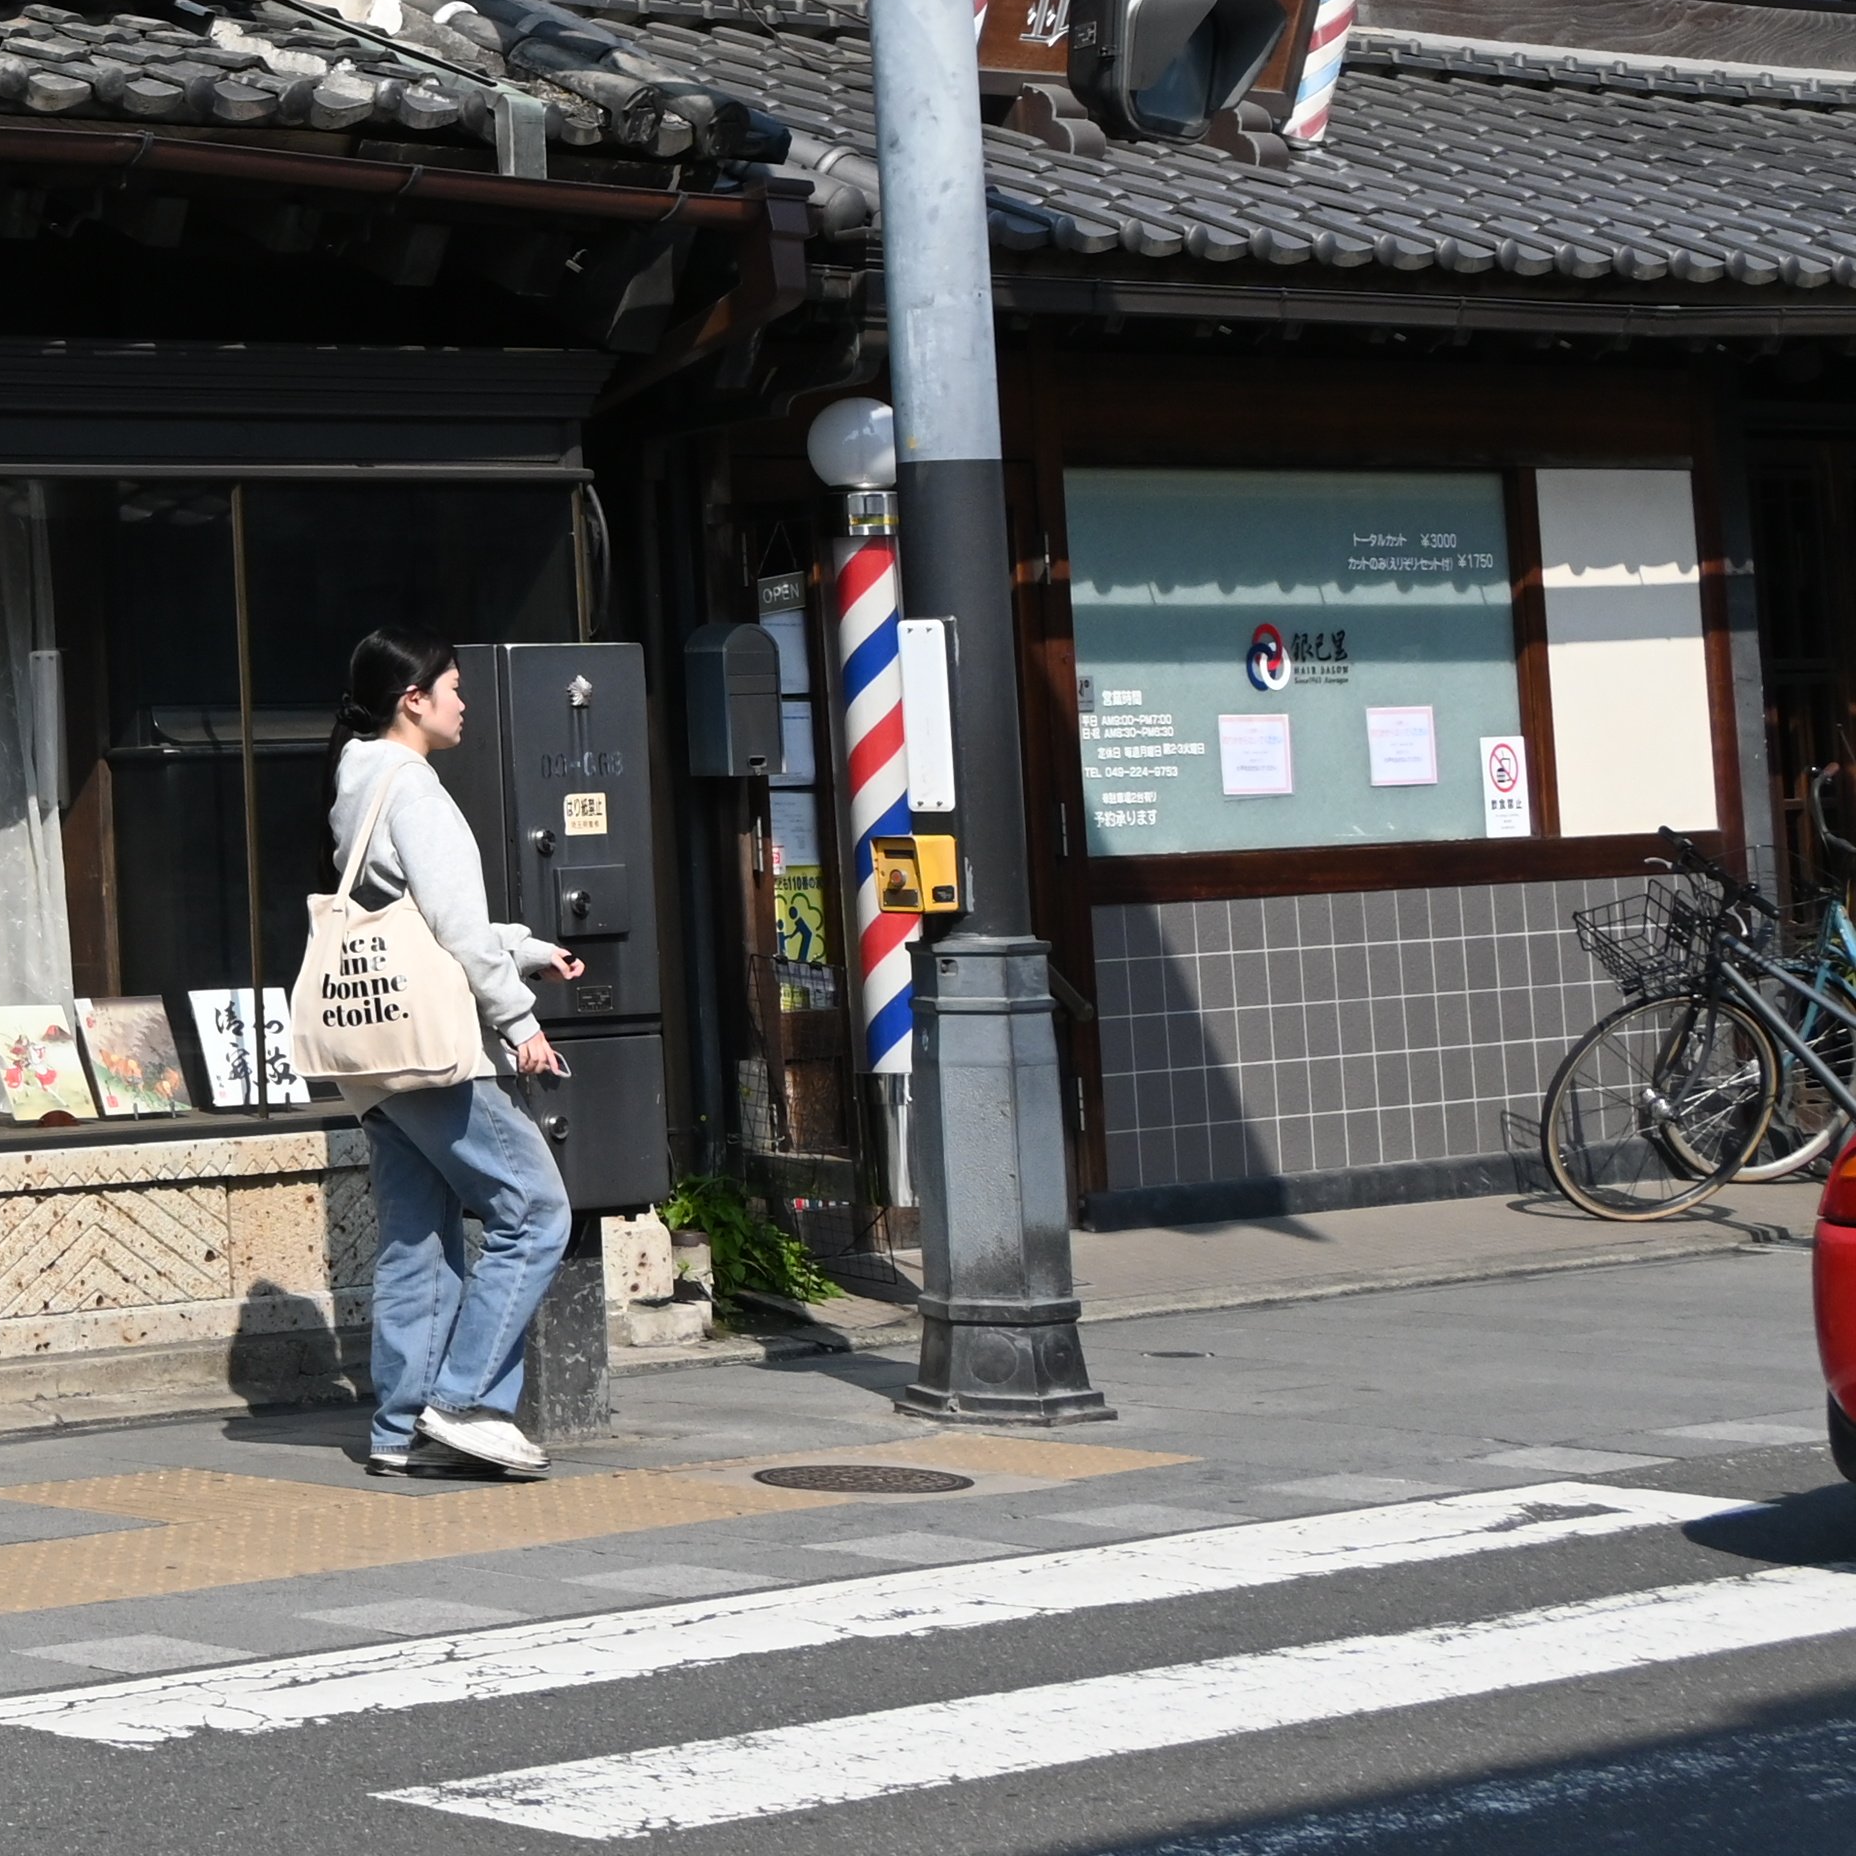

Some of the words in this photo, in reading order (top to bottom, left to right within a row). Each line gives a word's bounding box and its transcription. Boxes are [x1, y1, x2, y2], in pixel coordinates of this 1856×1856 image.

[1353, 532, 1408, 547] トータルカット
[1420, 533, 1457, 549] ¥3000
[1456, 553, 1494, 569] ¥1750
[762, 582, 800, 604] OPEN
[1294, 666, 1317, 675] HAIR
[1102, 690, 1142, 706] 営業時間
[1085, 767, 1102, 778] TEL
[1490, 798, 1523, 811] 飲食禁止
[1094, 809, 1158, 828] 予約承ります
[322, 973, 408, 1000] bonne
[322, 997, 409, 1028] etoile.
